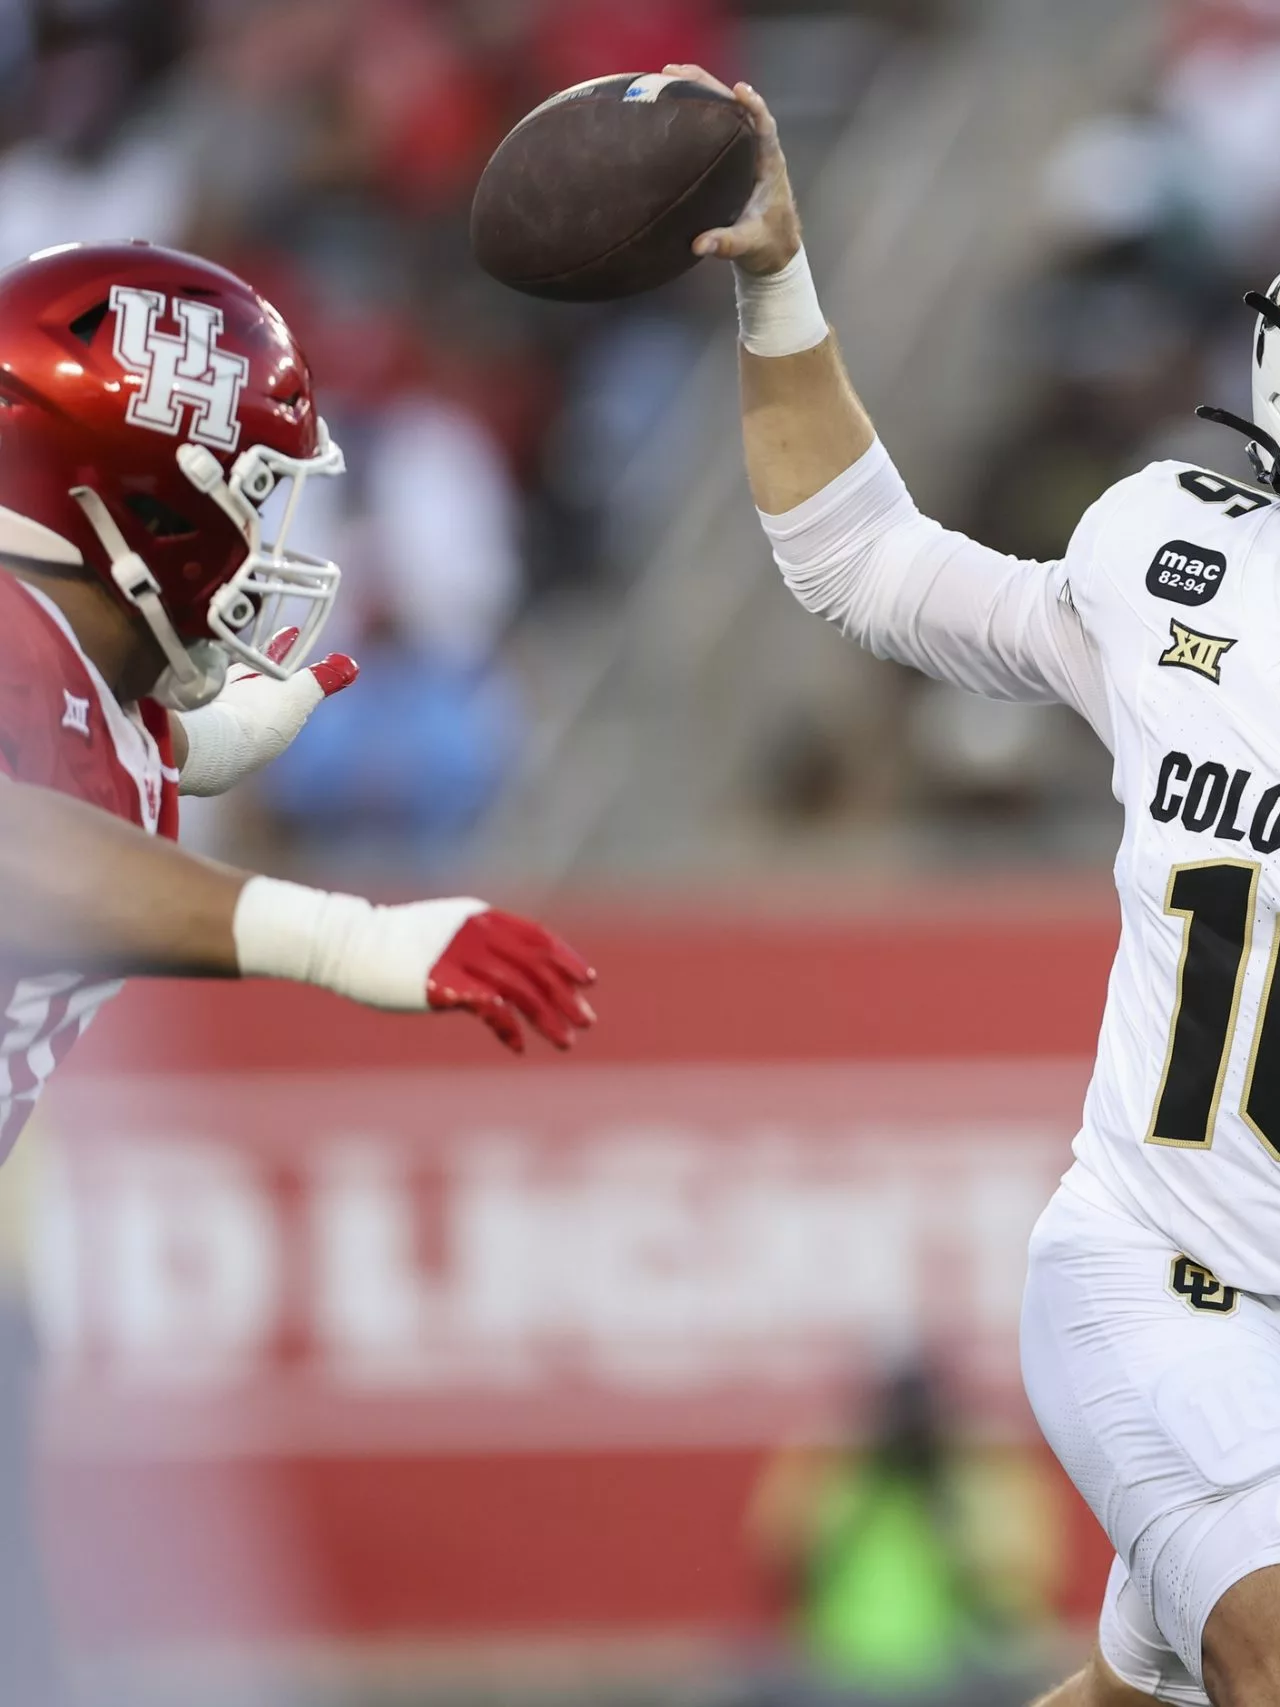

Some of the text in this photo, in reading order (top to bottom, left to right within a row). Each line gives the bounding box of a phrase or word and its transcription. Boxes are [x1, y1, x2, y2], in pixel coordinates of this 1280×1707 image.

[109, 285, 249, 452] UH
[1158, 549, 1221, 581] mac
[1158, 570, 1208, 595] 82-94
[1158, 618, 1239, 685] XII
